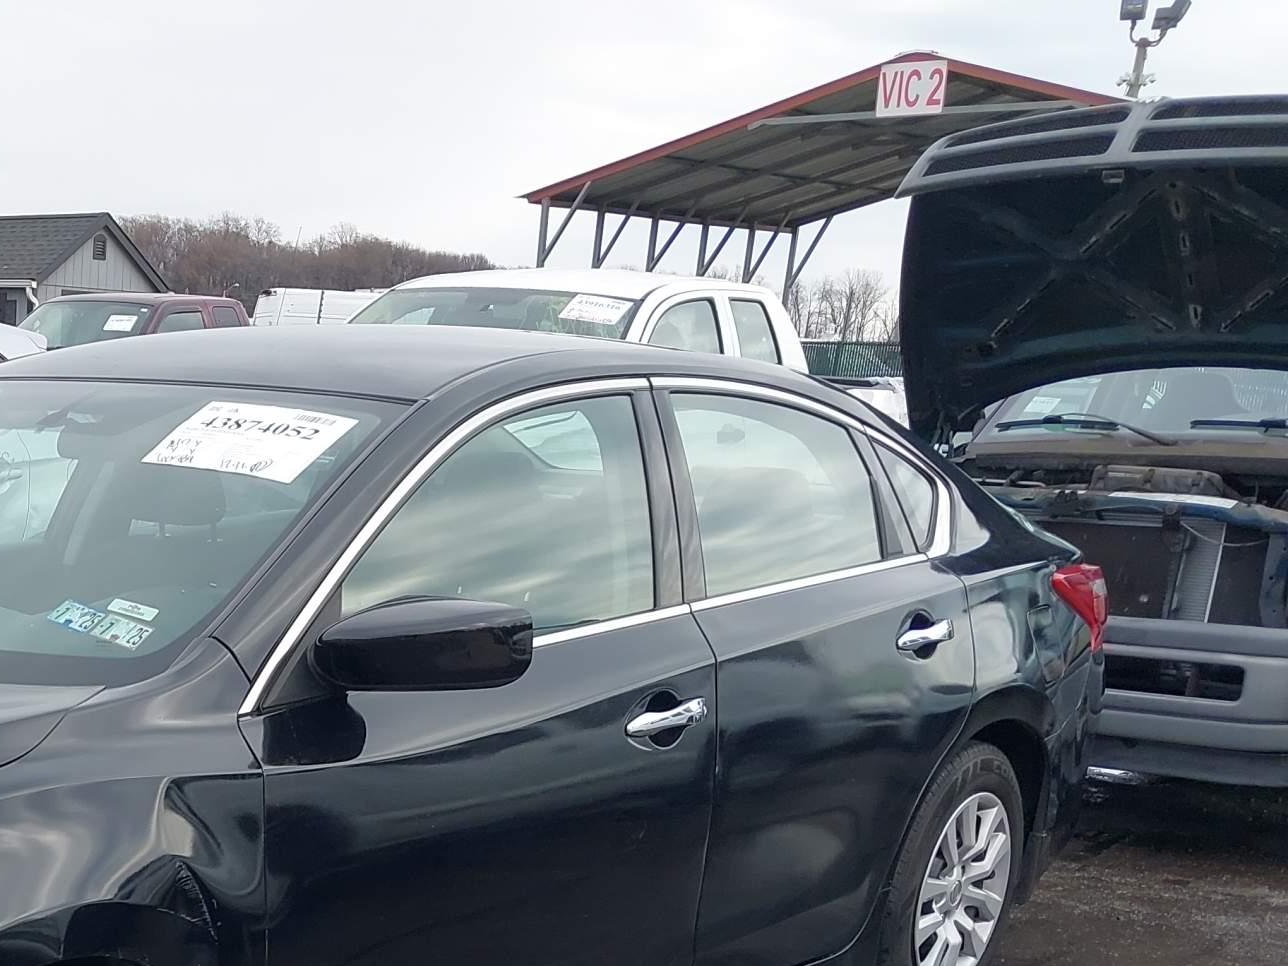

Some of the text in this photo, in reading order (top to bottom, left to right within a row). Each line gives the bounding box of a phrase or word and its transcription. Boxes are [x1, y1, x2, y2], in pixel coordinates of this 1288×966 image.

[882, 68, 944, 108] VIC 2
[200, 415, 321, 440] 43874052
